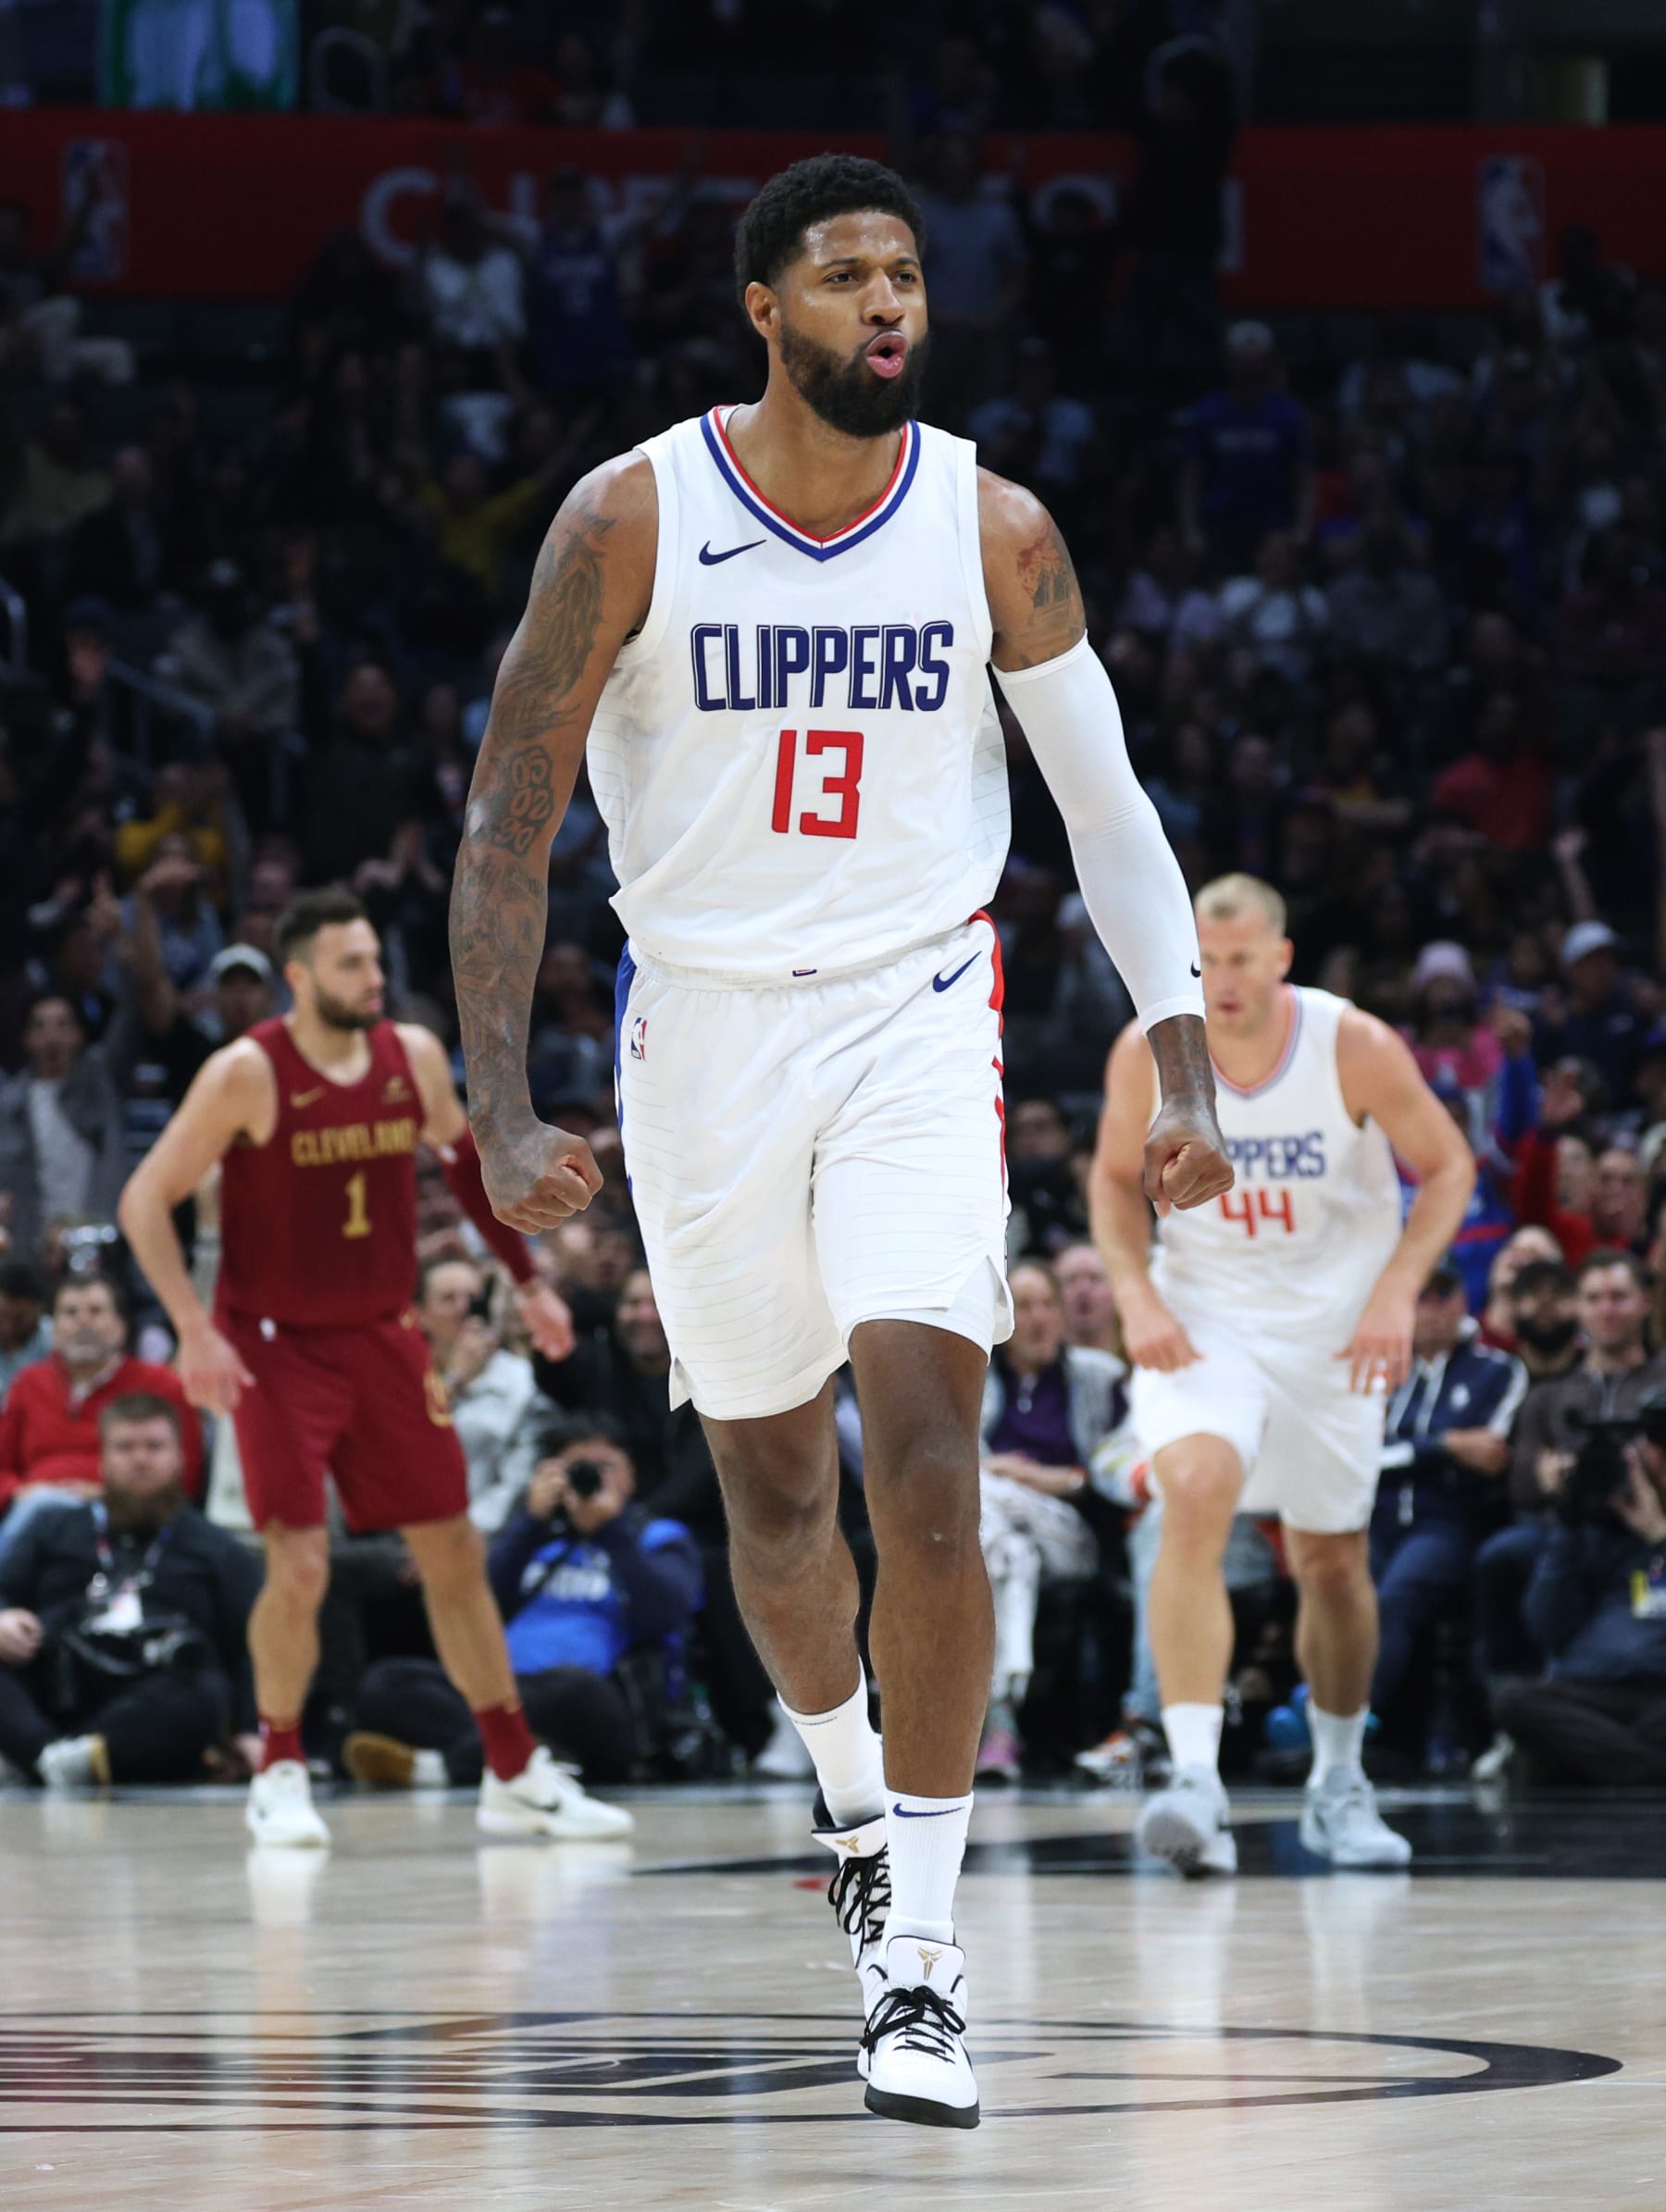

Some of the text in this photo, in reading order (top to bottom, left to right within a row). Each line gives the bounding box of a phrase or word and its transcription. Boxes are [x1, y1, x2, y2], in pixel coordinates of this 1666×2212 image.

[690, 620, 954, 712] CLIPPERS
[771, 729, 864, 839] 13
[1224, 1130, 1325, 1179] PPERS
[342, 1171, 370, 1238] 1
[1220, 1187, 1294, 1238] 44
